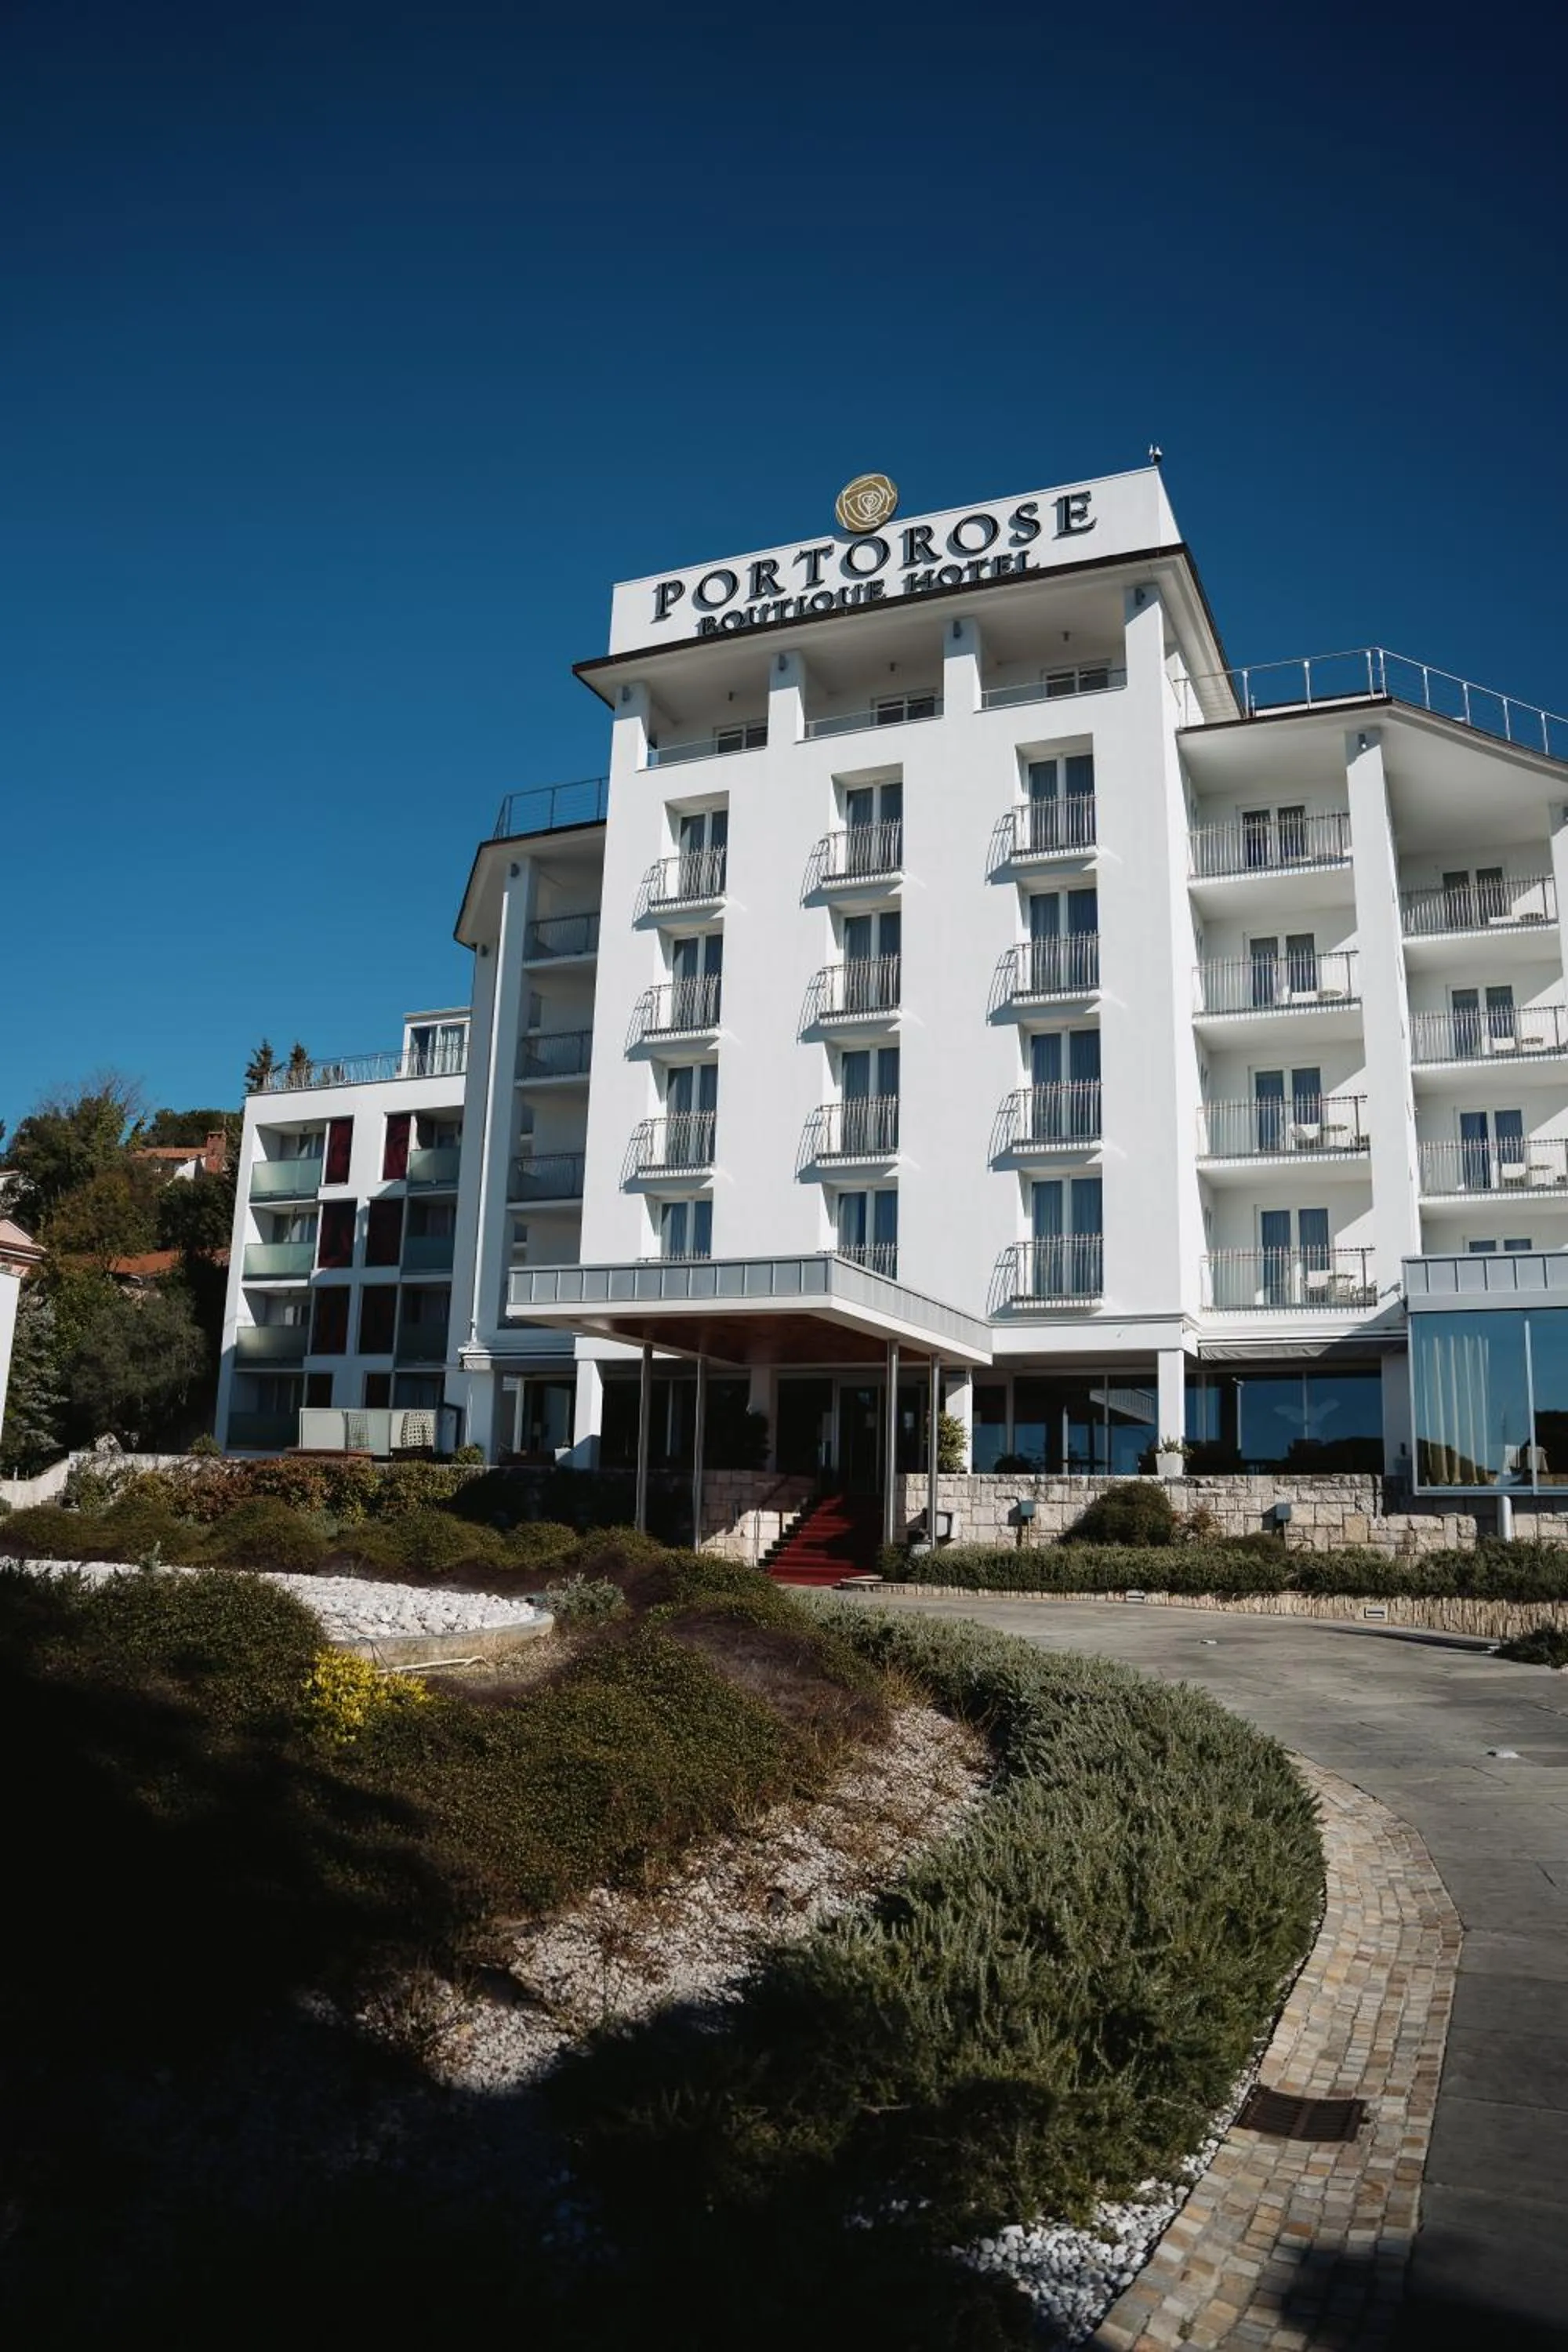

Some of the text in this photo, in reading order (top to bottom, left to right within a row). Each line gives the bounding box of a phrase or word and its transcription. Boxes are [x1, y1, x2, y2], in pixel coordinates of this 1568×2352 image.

[654, 491, 1098, 622] PORTOROSE
[698, 550, 1040, 636] BOUTIQUE HOTEL
